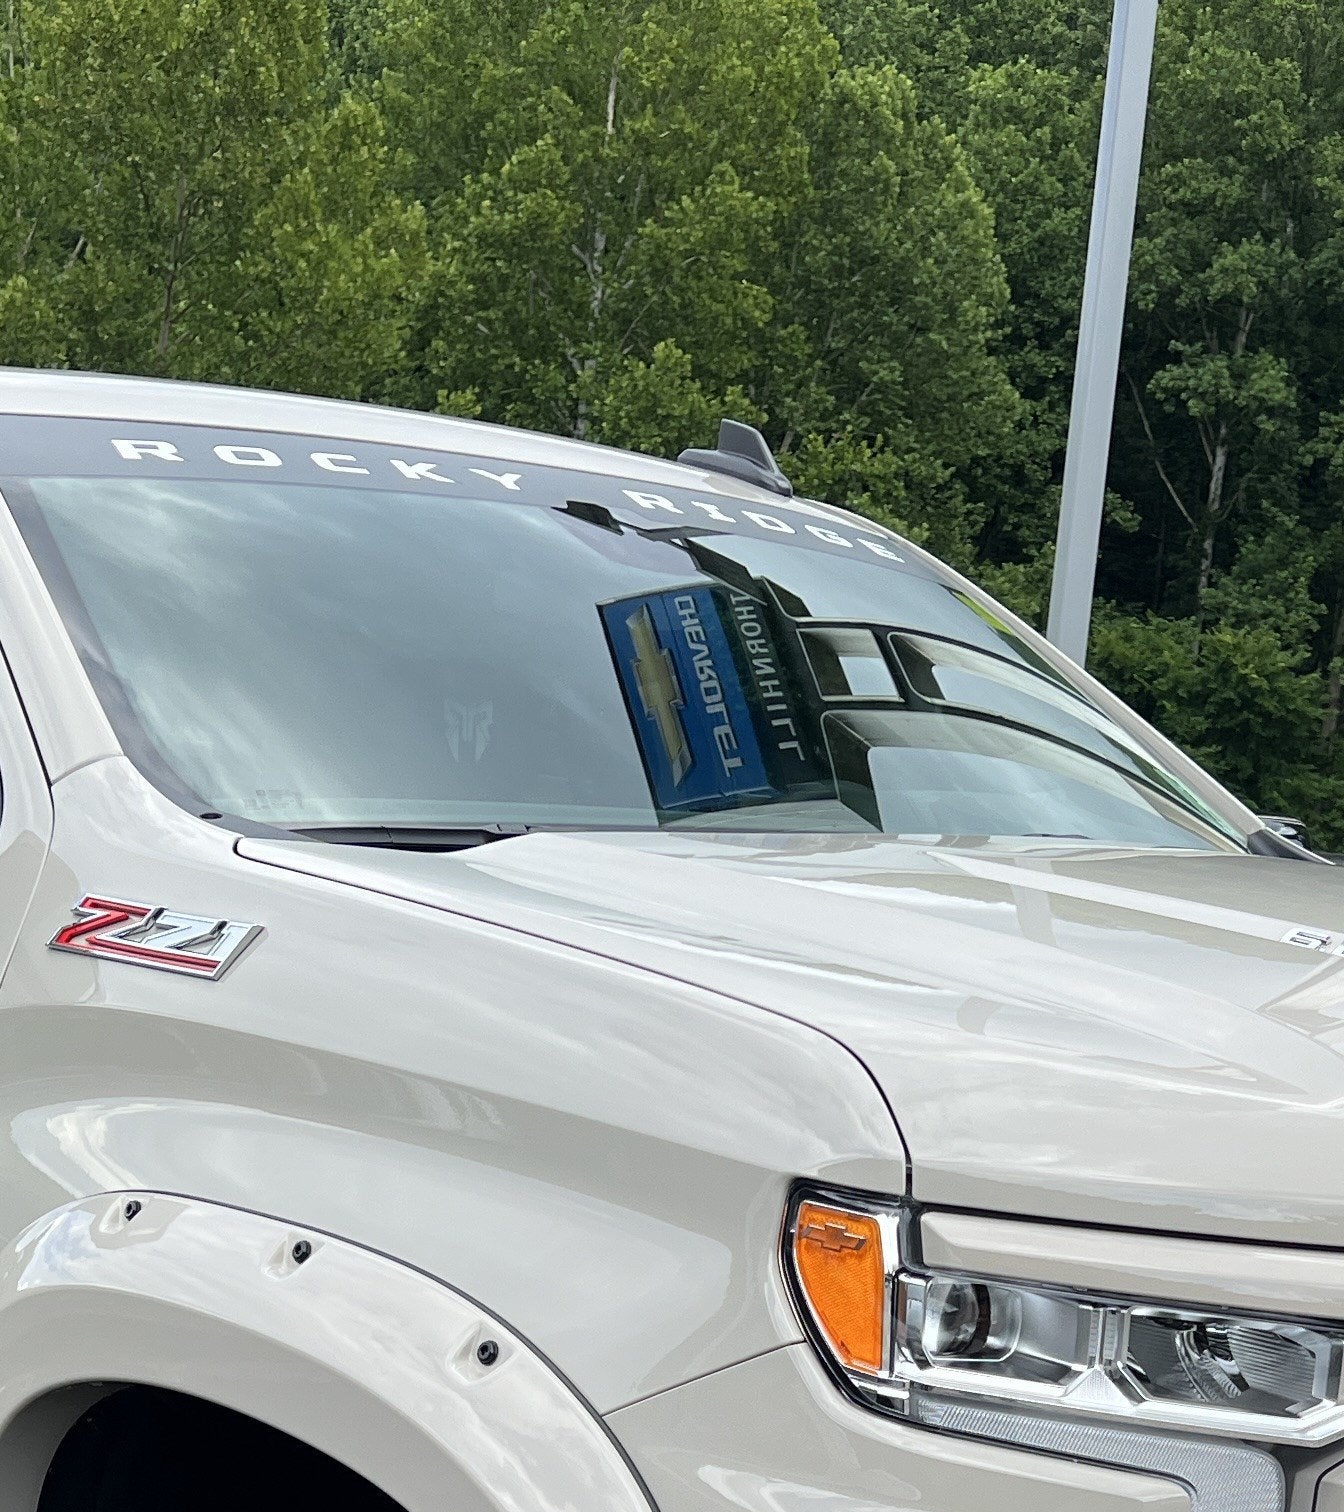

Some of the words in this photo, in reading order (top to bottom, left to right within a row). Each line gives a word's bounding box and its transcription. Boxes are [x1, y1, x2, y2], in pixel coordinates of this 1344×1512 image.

[111, 438, 523, 491] ROCKY
[621, 489, 907, 564] RIDGE
[45, 892, 268, 982] Z71
